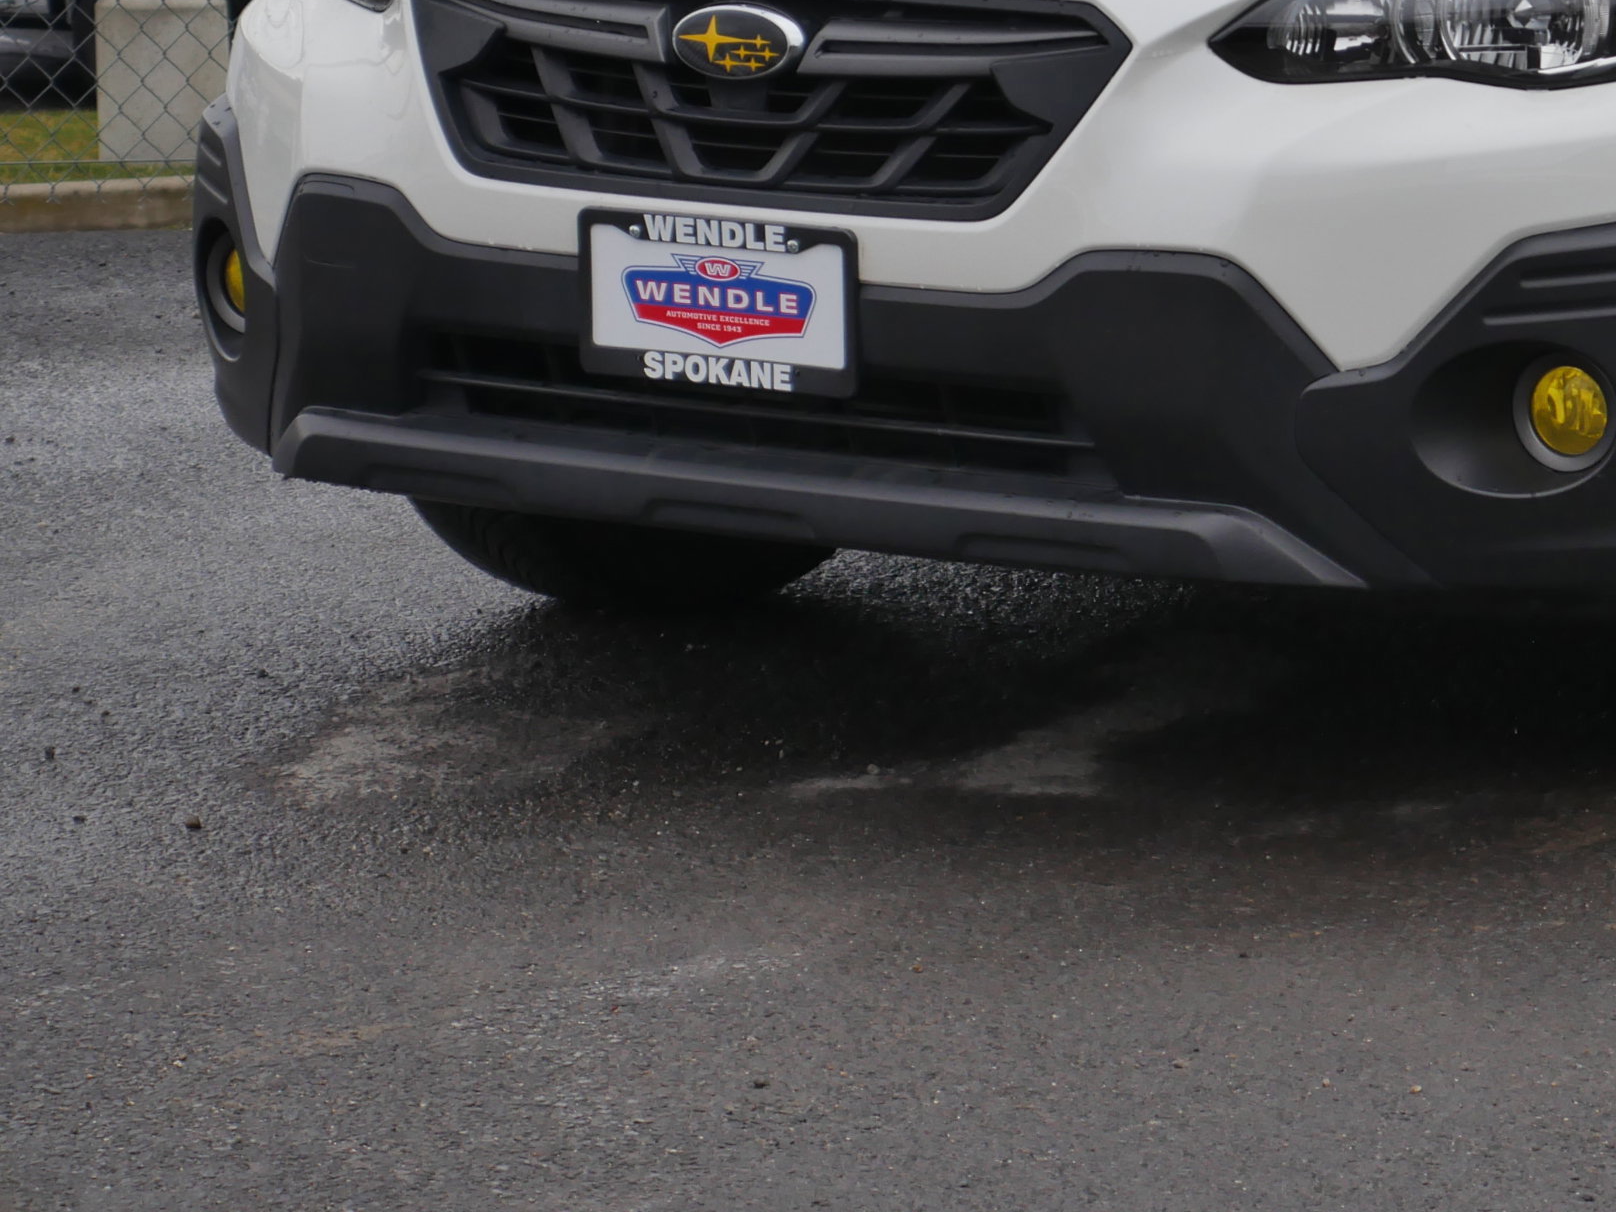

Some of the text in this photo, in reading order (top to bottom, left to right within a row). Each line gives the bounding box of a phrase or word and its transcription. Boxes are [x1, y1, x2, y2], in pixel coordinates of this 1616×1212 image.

[643, 213, 787, 252] WENDLE
[635, 279, 798, 315] WENDLE
[665, 309, 770, 327] AUTOMOTIVE EXCELLENCE
[697, 322, 721, 331] SINCE
[643, 351, 793, 392] SPOKANE
